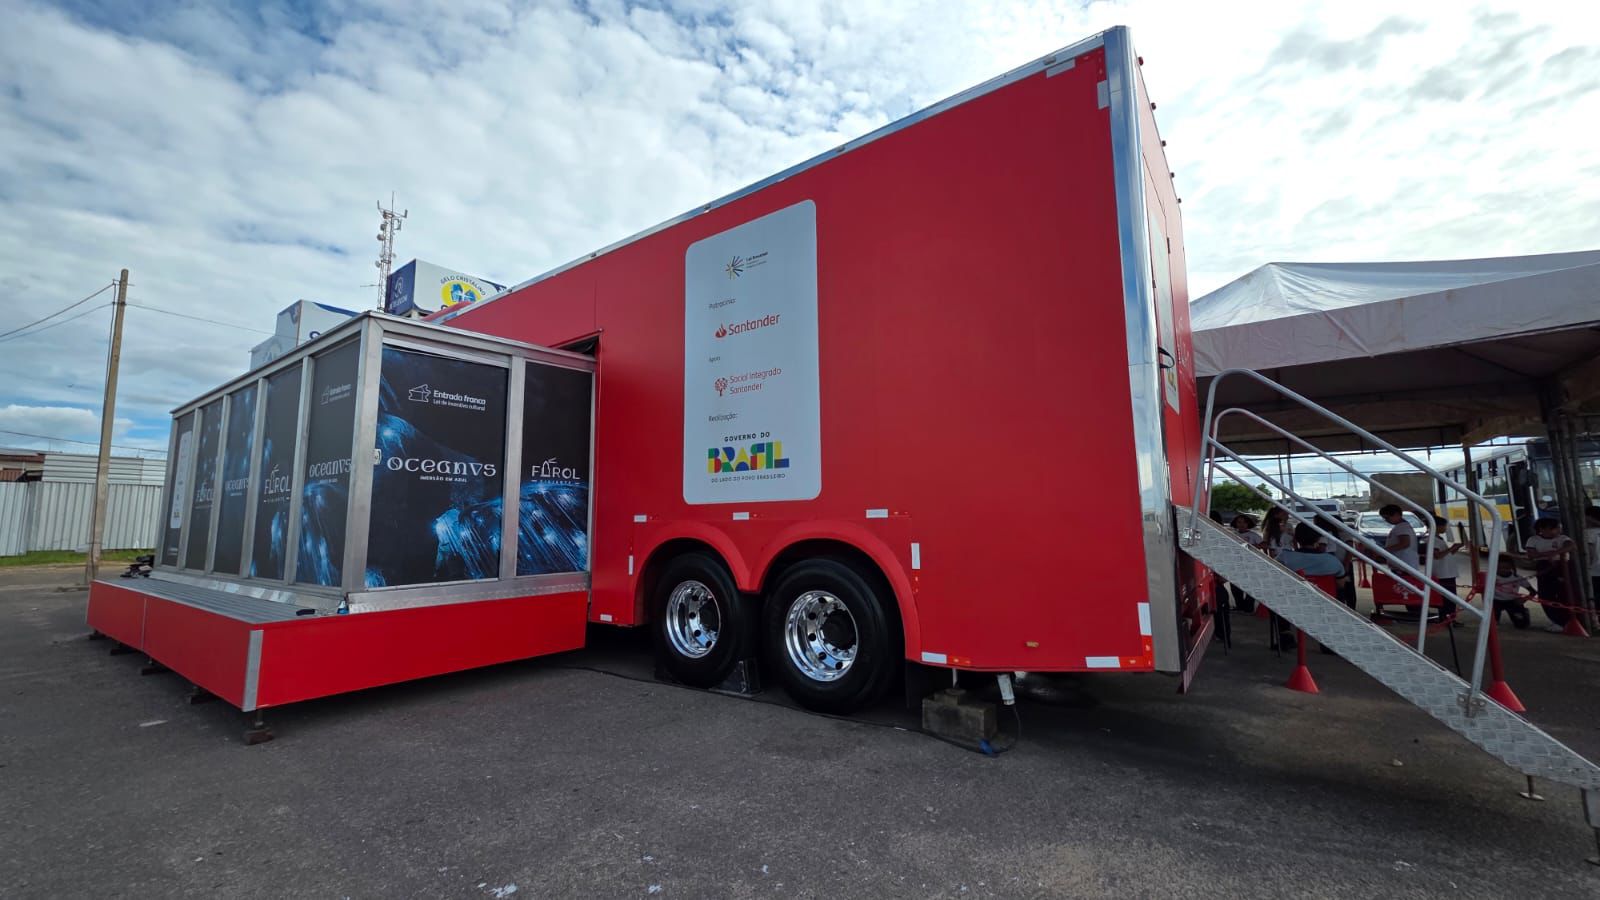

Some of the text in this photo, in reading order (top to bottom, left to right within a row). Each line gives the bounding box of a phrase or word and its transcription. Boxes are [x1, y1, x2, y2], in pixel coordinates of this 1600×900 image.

[728, 314, 781, 335] Santander
[729, 367, 782, 384] Social Integrado
[729, 382, 762, 395] Santander
[433, 389, 486, 405] Entrada franca
[724, 433, 757, 441] GOVERNO
[708, 441, 790, 473] BRASIL
